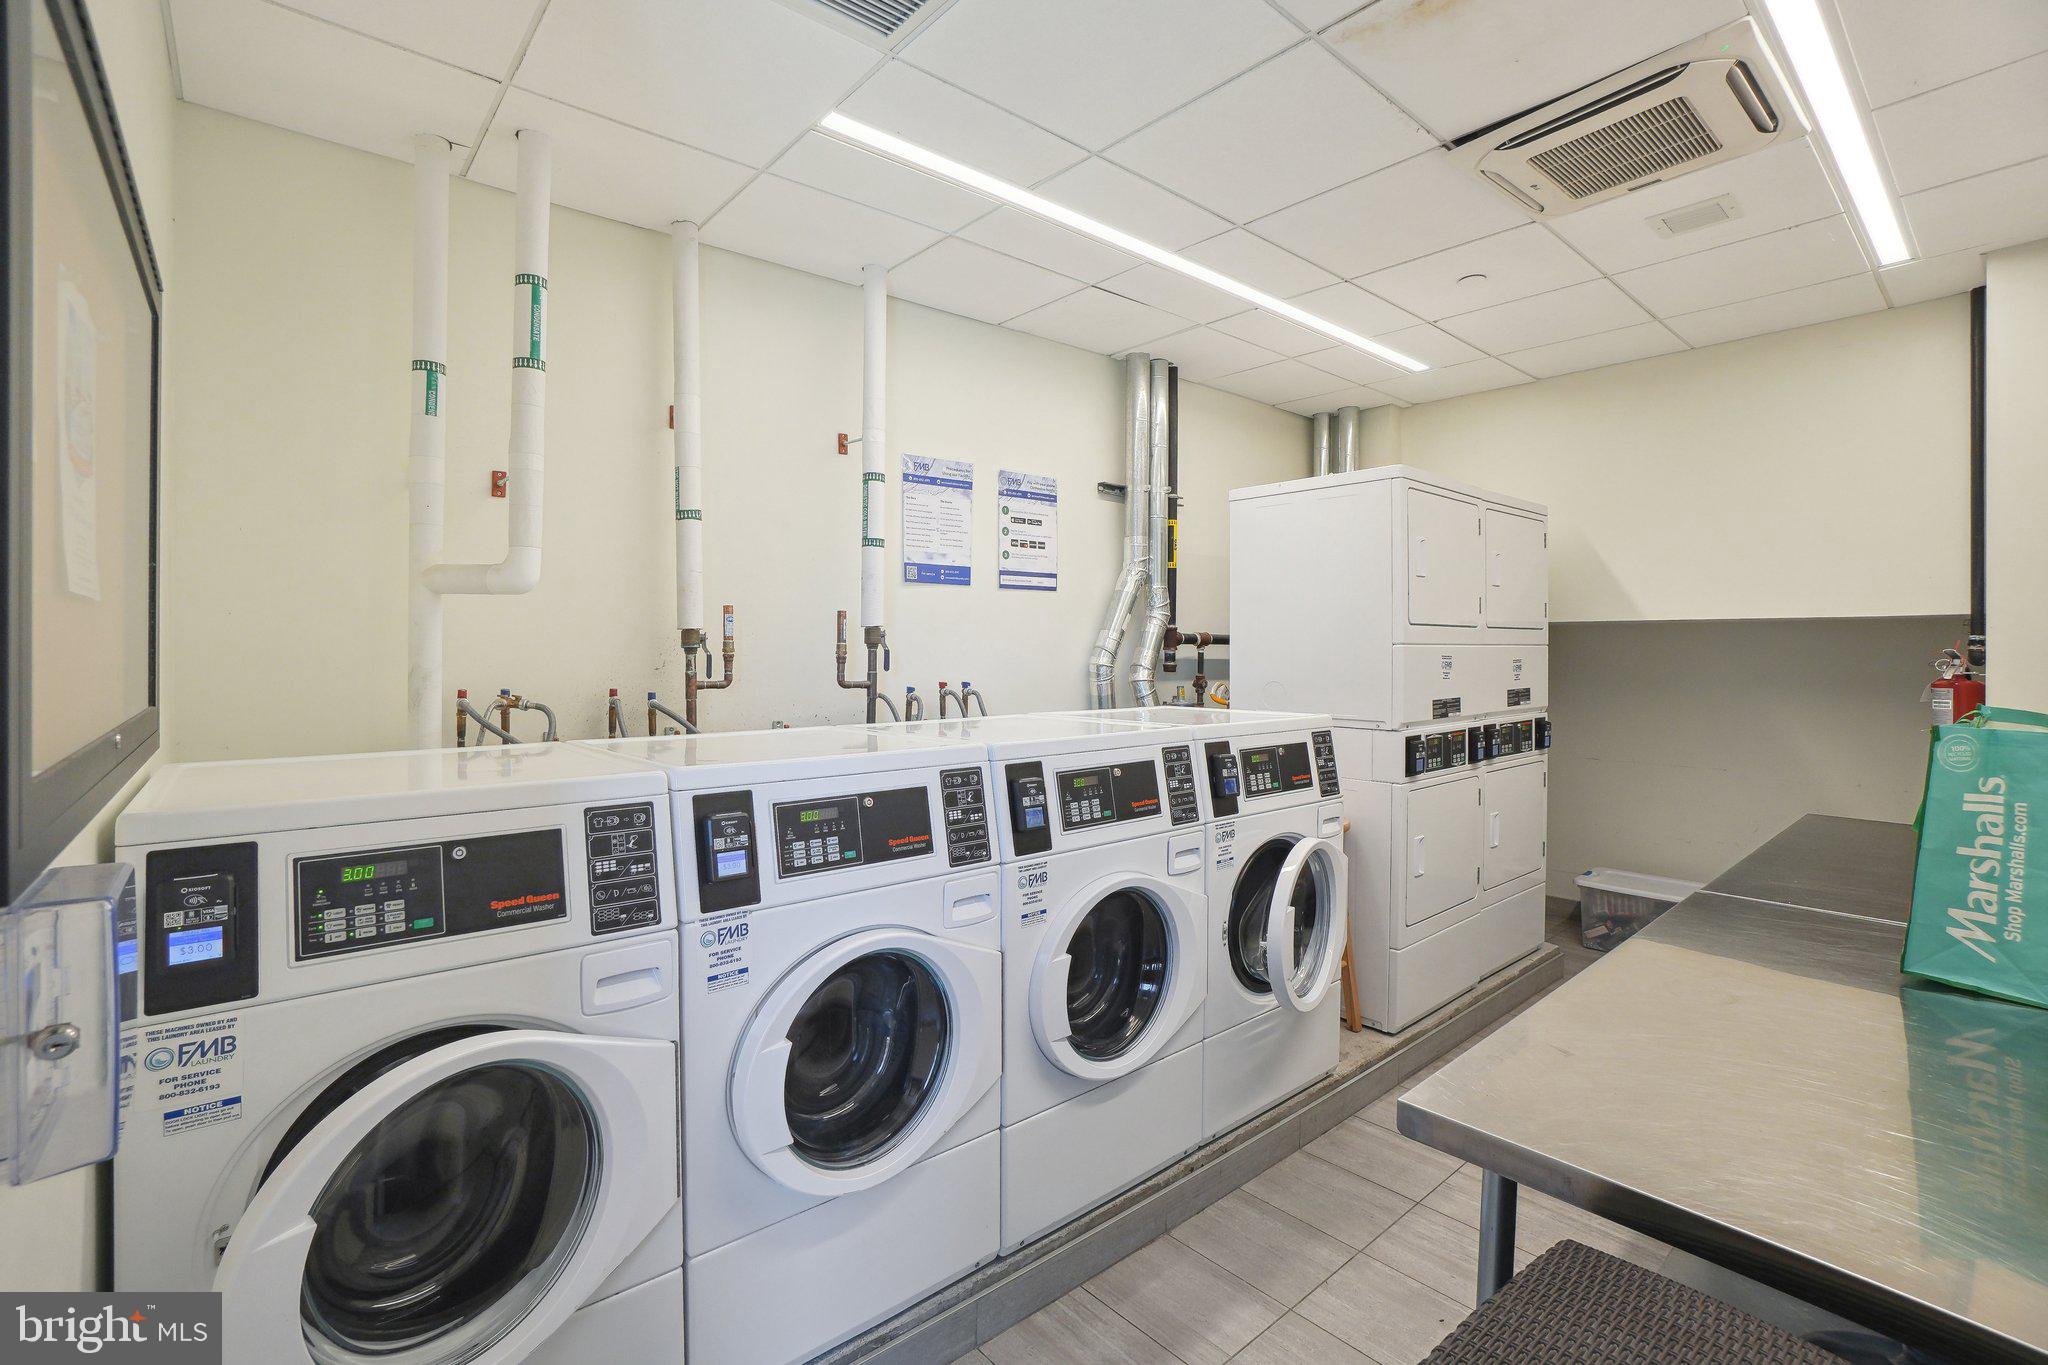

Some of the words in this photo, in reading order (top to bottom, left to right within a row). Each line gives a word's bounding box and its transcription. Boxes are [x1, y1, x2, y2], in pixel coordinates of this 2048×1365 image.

[533, 304, 541, 342] CONDENSATE
[914, 462, 930, 472] FMB
[888, 837, 909, 847] Speed
[2005, 802, 2028, 900] Marshalls.com
[343, 866, 375, 882] 3.00
[1945, 776, 2006, 963] Marshalls
[1029, 872, 1048, 888] FMB
[490, 896, 524, 910] Speed
[526, 892, 560, 904] Queen
[496, 906, 532, 917] Commercial
[534, 902, 555, 912] Washer
[2004, 902, 2022, 942] Shop
[718, 922, 749, 945] FMB
[180, 943, 212, 956] $3.00
[716, 953, 734, 961] PHONE
[720, 946, 742, 955] SERVICE
[162, 1032, 188, 1041] LAUNDRY
[164, 1025, 194, 1033] MACHINES
[178, 1035, 237, 1068] FMB
[190, 1053, 235, 1067] LAUNDRY
[159, 1076, 178, 1085] FOR
[181, 1068, 222, 1080] SERVICE
[174, 1078, 206, 1090] PHONE
[158, 1084, 220, 1100] 800-832-6193
[183, 1101, 224, 1116] NOTICE
